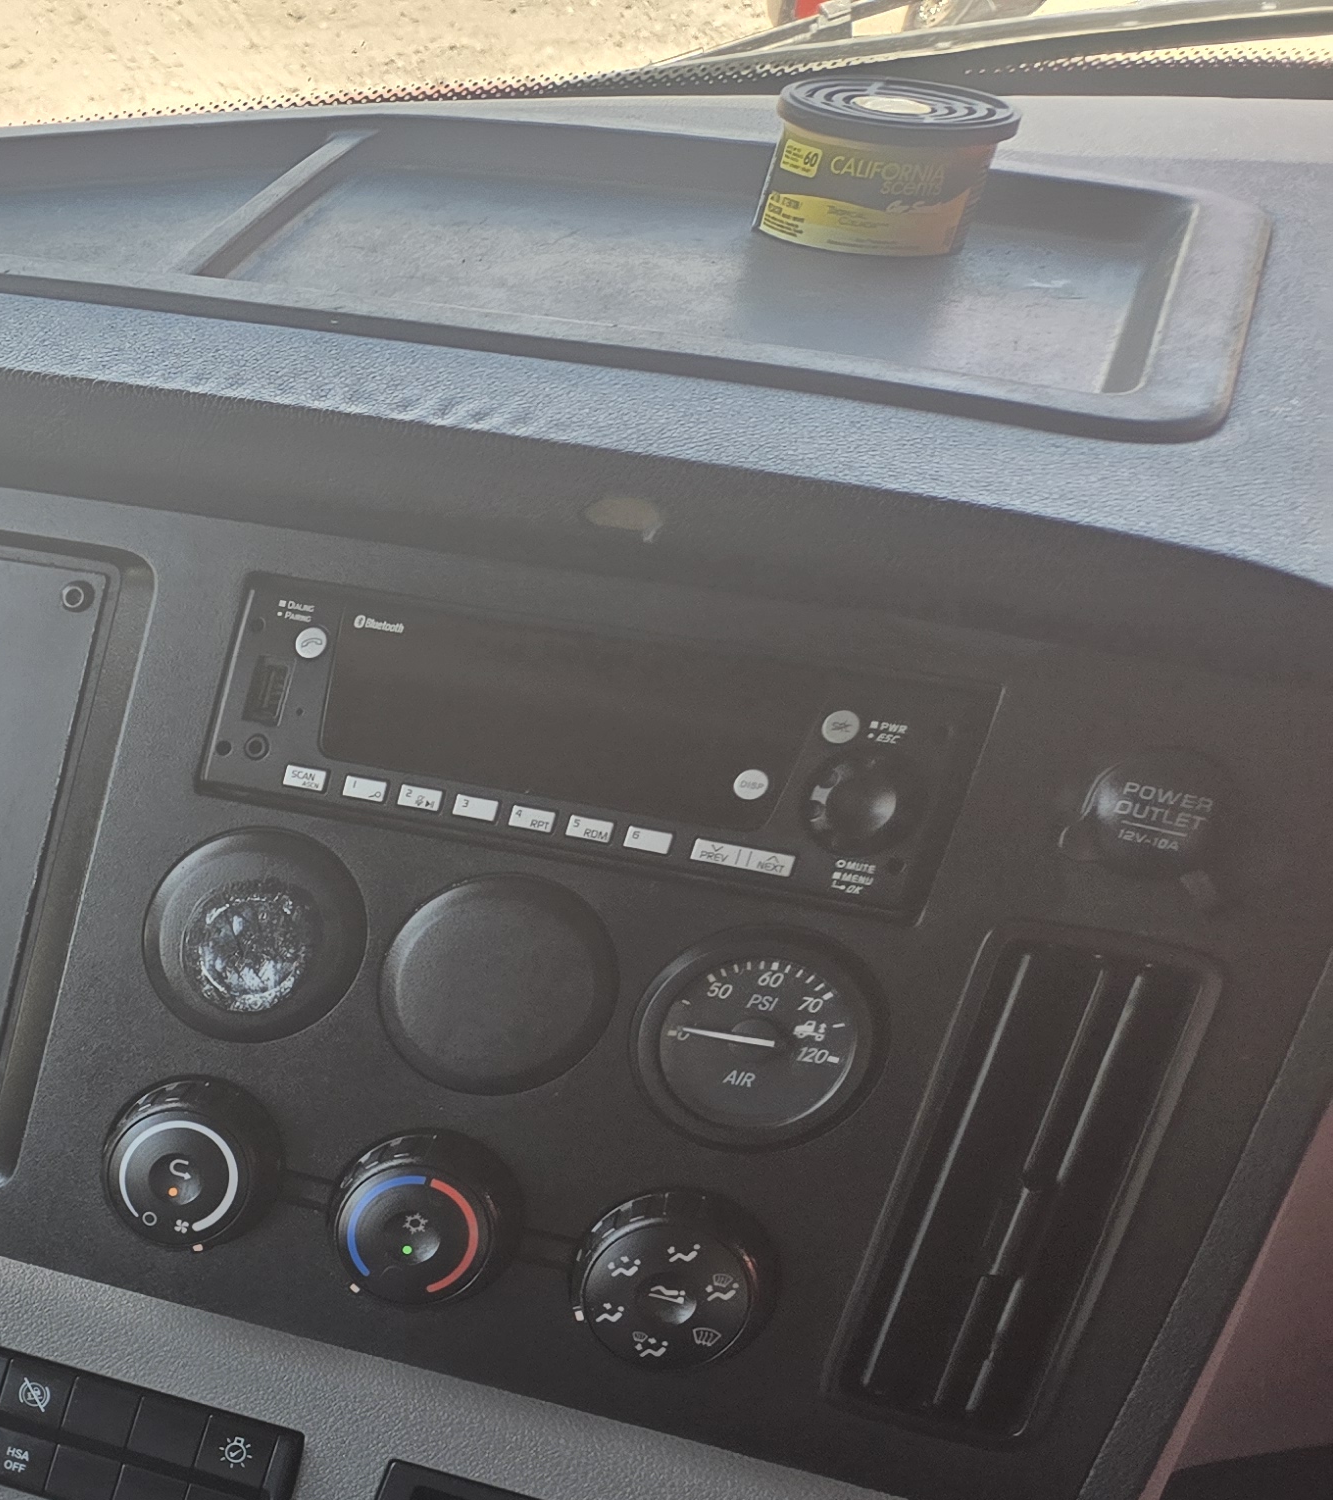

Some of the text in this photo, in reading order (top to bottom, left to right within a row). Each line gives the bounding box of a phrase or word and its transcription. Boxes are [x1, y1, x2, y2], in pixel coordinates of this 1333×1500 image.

[803, 151, 818, 168] 60
[831, 156, 945, 184] CALIFORNIA
[365, 617, 405, 634] Bluetooth
[879, 722, 908, 734] PWR
[876, 733, 901, 744] ESC
[290, 769, 316, 782] SCAN
[739, 780, 765, 790] DISP
[405, 788, 414, 798] 2
[1122, 782, 1214, 813] POWER
[462, 799, 470, 808] 3
[516, 809, 523, 818] 4
[1114, 800, 1209, 830] OUTLET
[530, 818, 550, 831] RPT
[573, 818, 581, 828] 5
[583, 827, 609, 841] RDM
[632, 831, 640, 840] 6
[1117, 829, 1180, 851] 12V-10A
[699, 850, 730, 863] PREV
[756, 860, 786, 874] NEXT
[846, 861, 877, 874] MUTE
[841, 872, 875, 886] MENU
[845, 885, 864, 895] OK
[757, 971, 784, 988] 60
[707, 982, 733, 1000] 50
[745, 994, 779, 1011] PSI
[797, 996, 824, 1013] 70
[796, 1047, 829, 1064] 120
[722, 1069, 756, 1087] AIR
[6, 1446, 30, 1463] HSA
[3, 1459, 27, 1474] OFF
